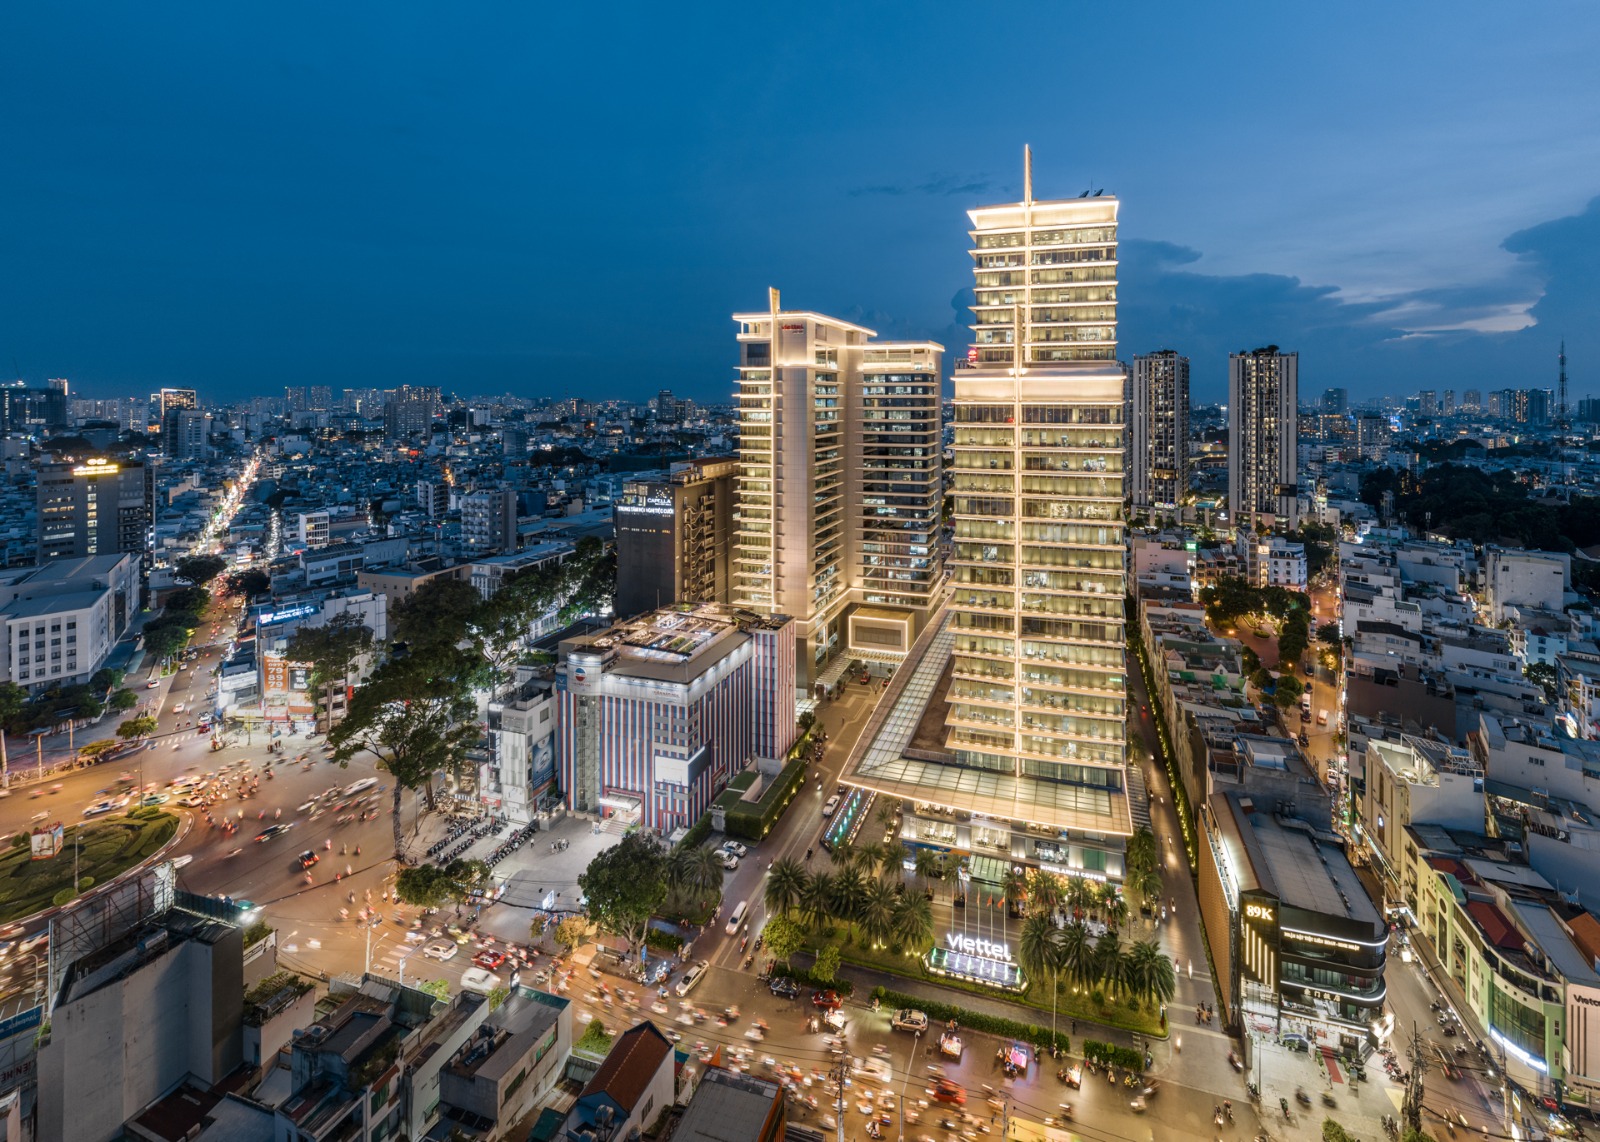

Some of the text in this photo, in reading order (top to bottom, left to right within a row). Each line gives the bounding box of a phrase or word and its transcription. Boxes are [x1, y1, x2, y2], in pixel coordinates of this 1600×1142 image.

[1040, 864, 1107, 882] HIGHLANDS COFFEE
[1246, 904, 1273, 921] 89K
[946, 933, 1011, 961] viettel
